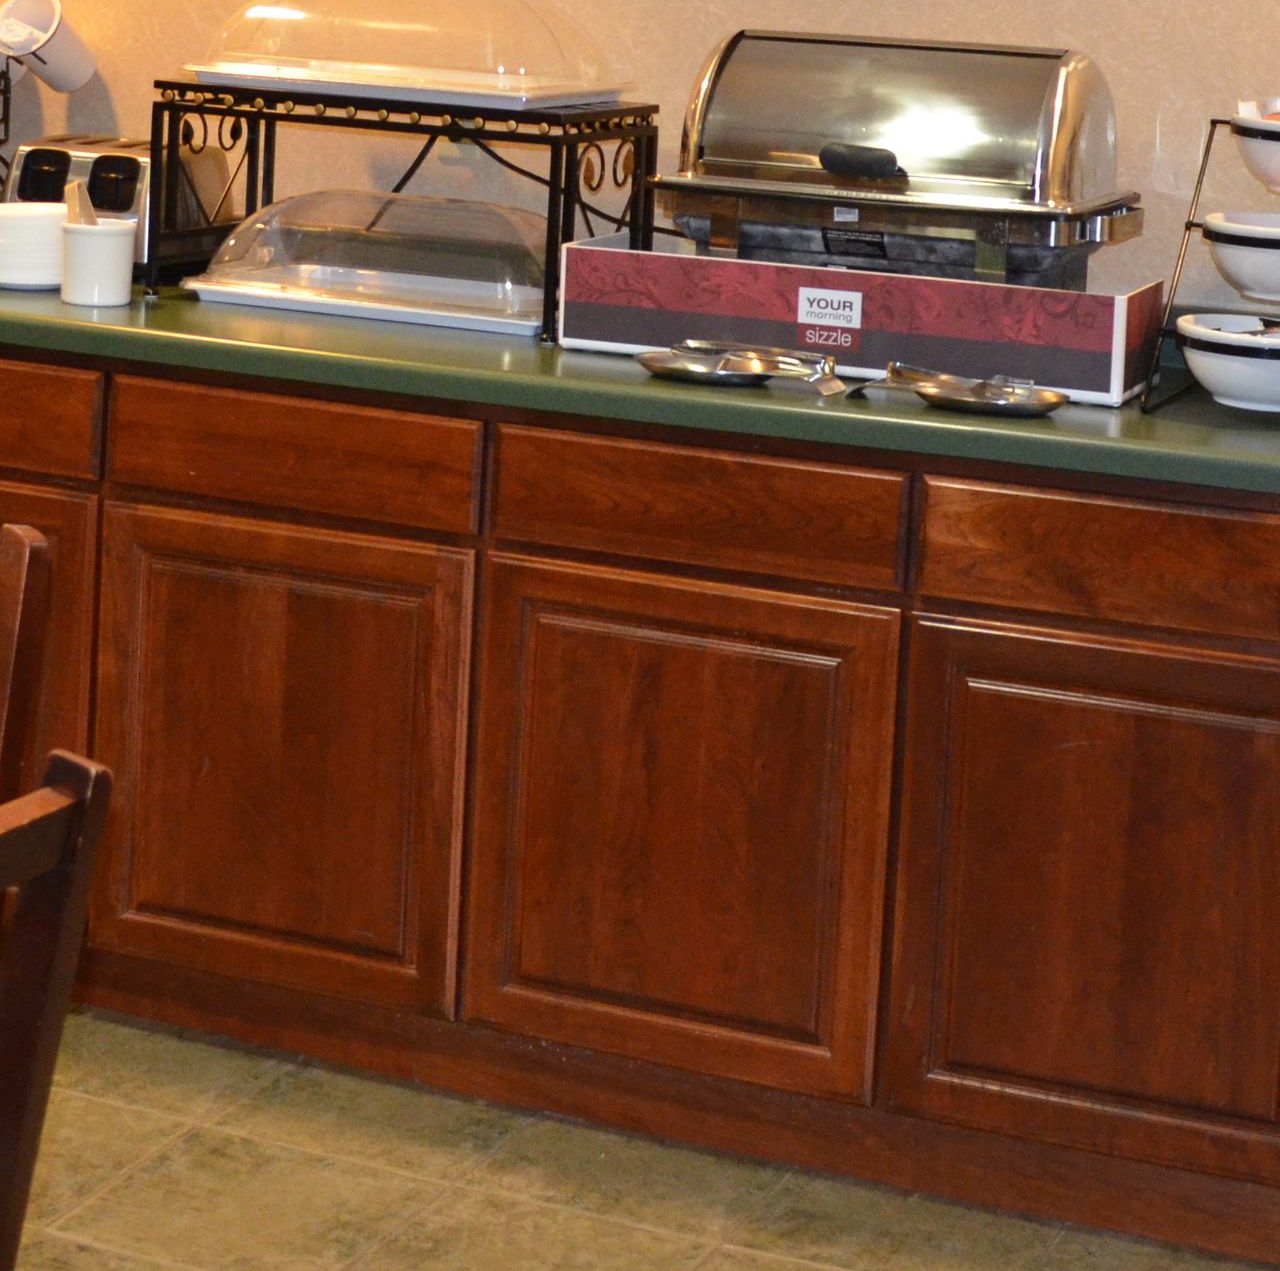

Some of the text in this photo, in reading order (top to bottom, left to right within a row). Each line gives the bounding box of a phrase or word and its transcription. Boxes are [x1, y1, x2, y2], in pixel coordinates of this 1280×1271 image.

[806, 297, 853, 312] YOUR
[806, 311, 853, 324] morning
[806, 327, 852, 347] sizzle
